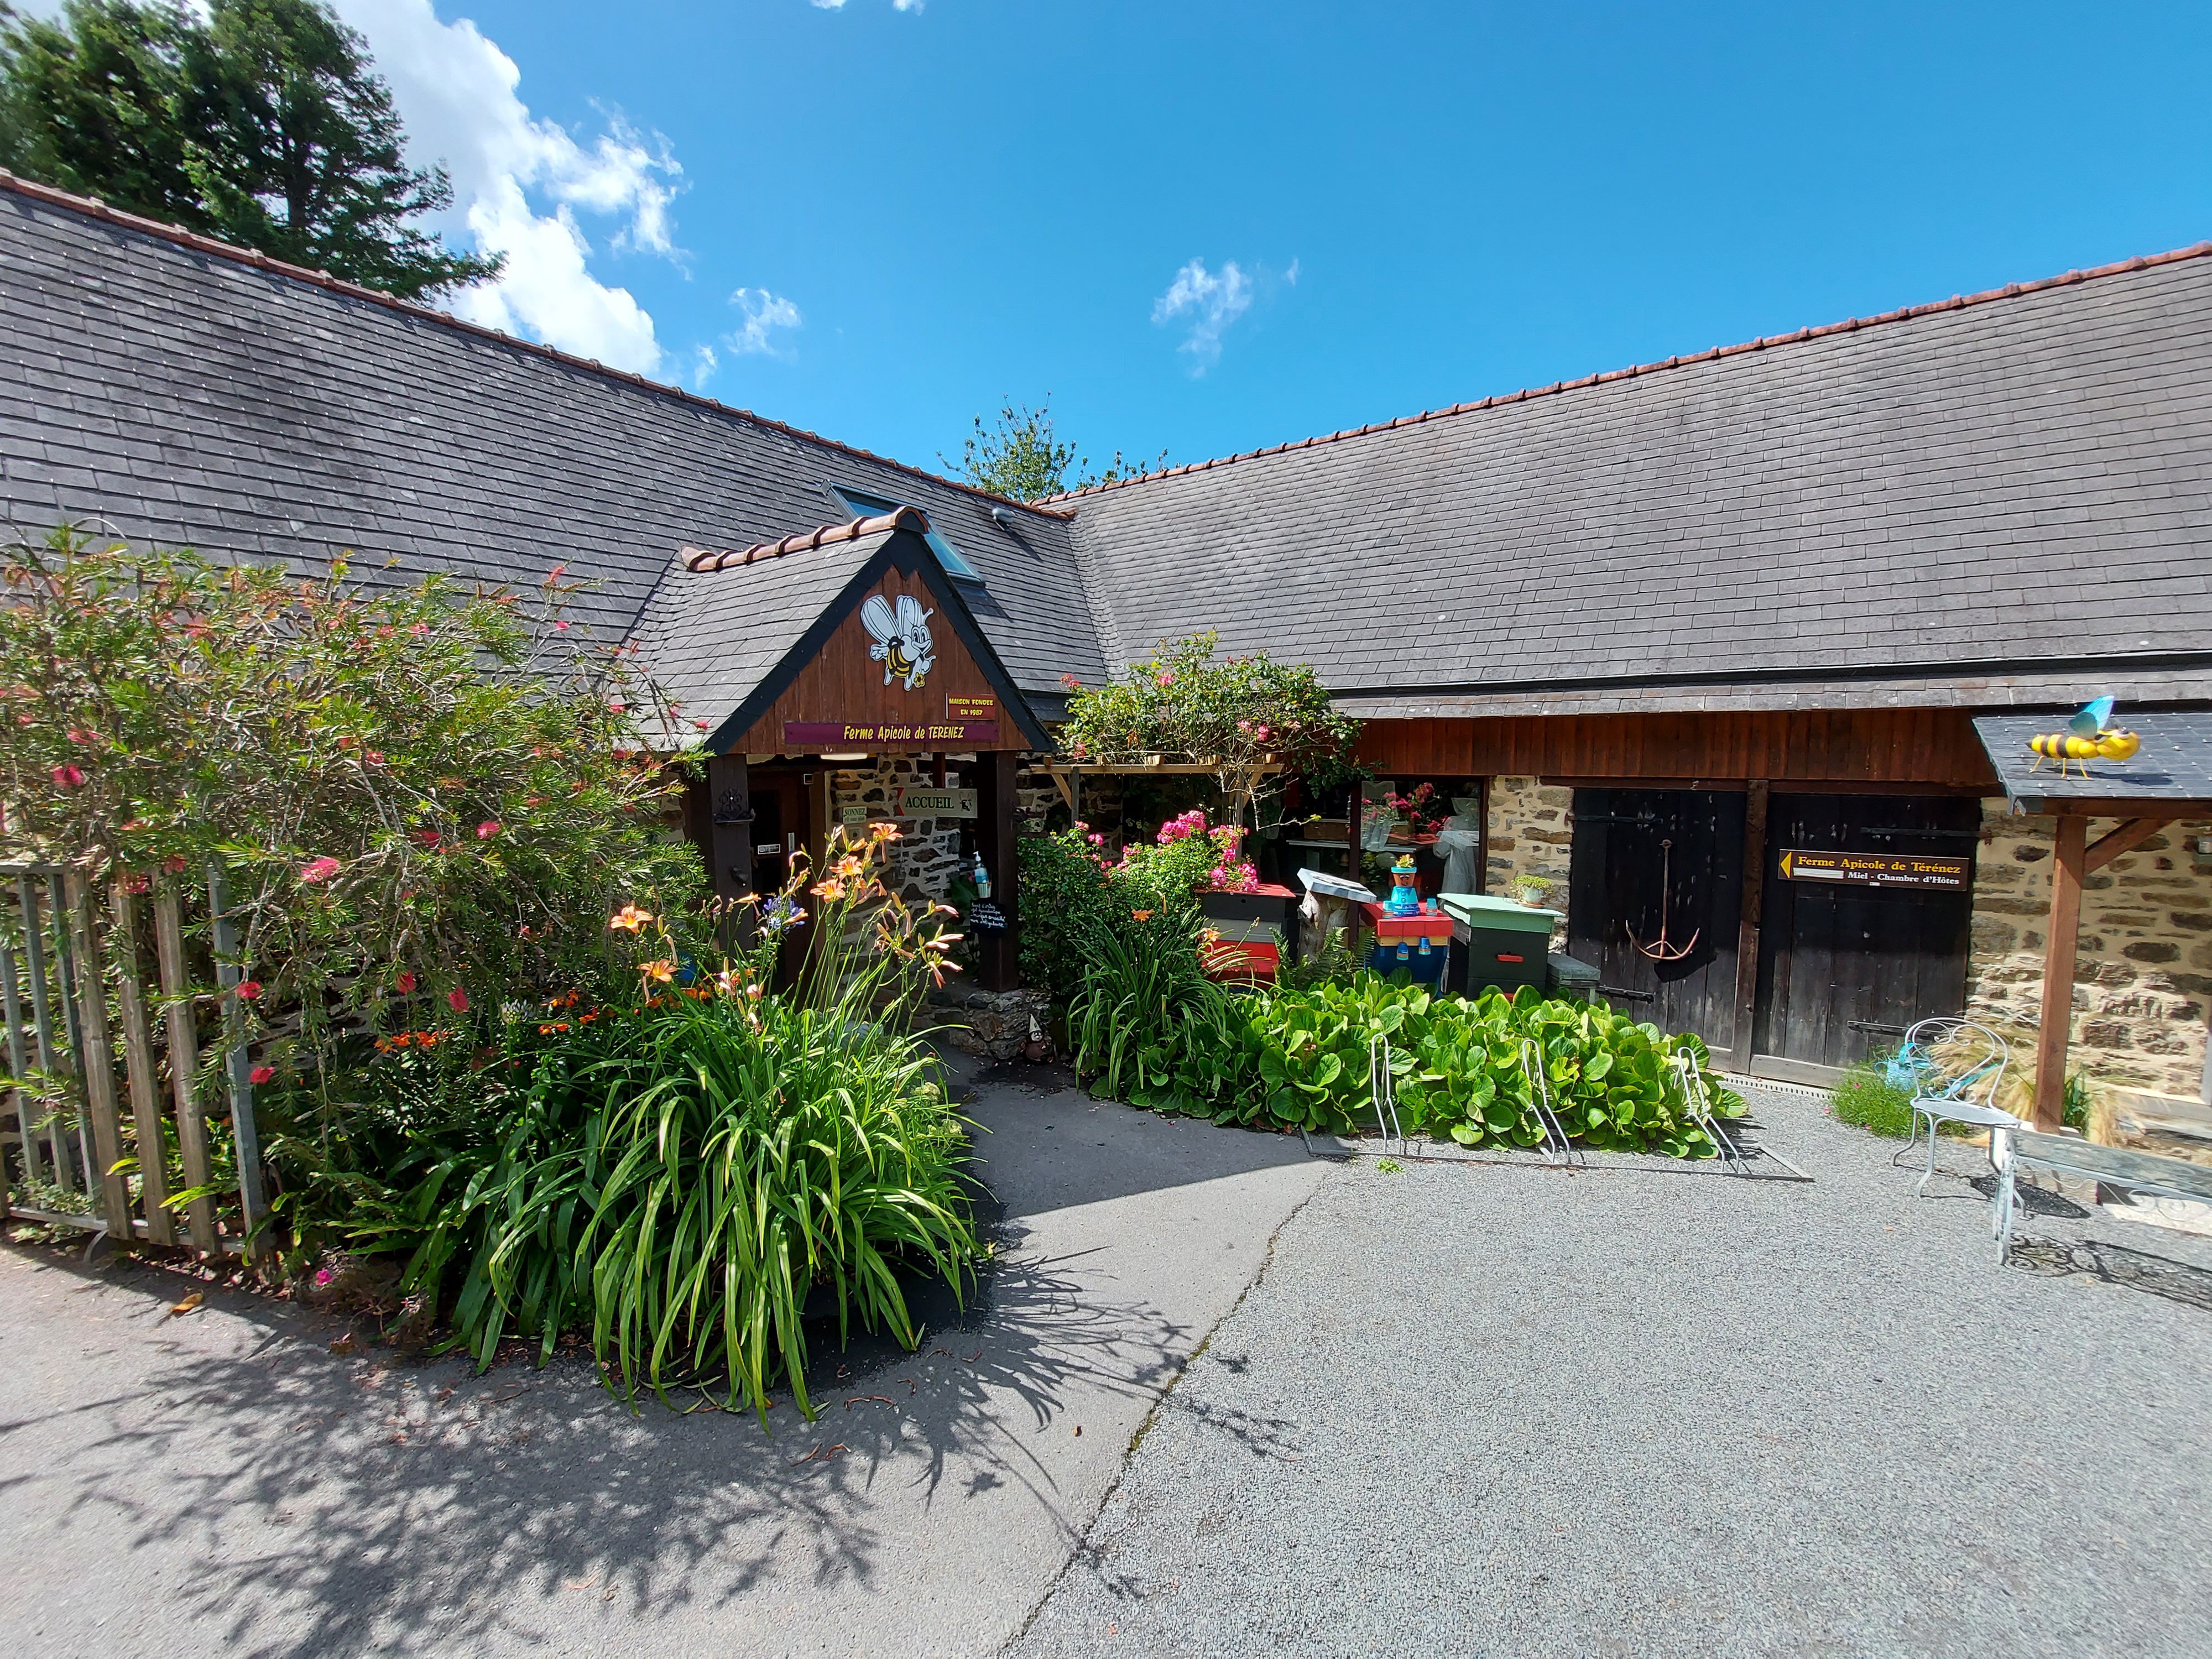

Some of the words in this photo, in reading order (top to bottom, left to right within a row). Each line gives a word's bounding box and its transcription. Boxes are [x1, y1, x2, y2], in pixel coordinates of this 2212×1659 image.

[844, 726, 874, 740] Ferme
[878, 725, 911, 742] Apicole
[914, 726, 925, 739] de
[928, 726, 964, 739] TERENEZ
[905, 796, 954, 809] ACCUEIL
[844, 808, 865, 816] SONNEZ
[1798, 856, 1835, 867] Ferme
[1840, 858, 1886, 870] Apicole
[1891, 862, 1907, 870] de
[1911, 862, 1961, 874] Térénez
[1848, 871, 1869, 879] Miel
[1877, 873, 1919, 883] Chambre
[1923, 875, 1960, 885] d'Hôtes
